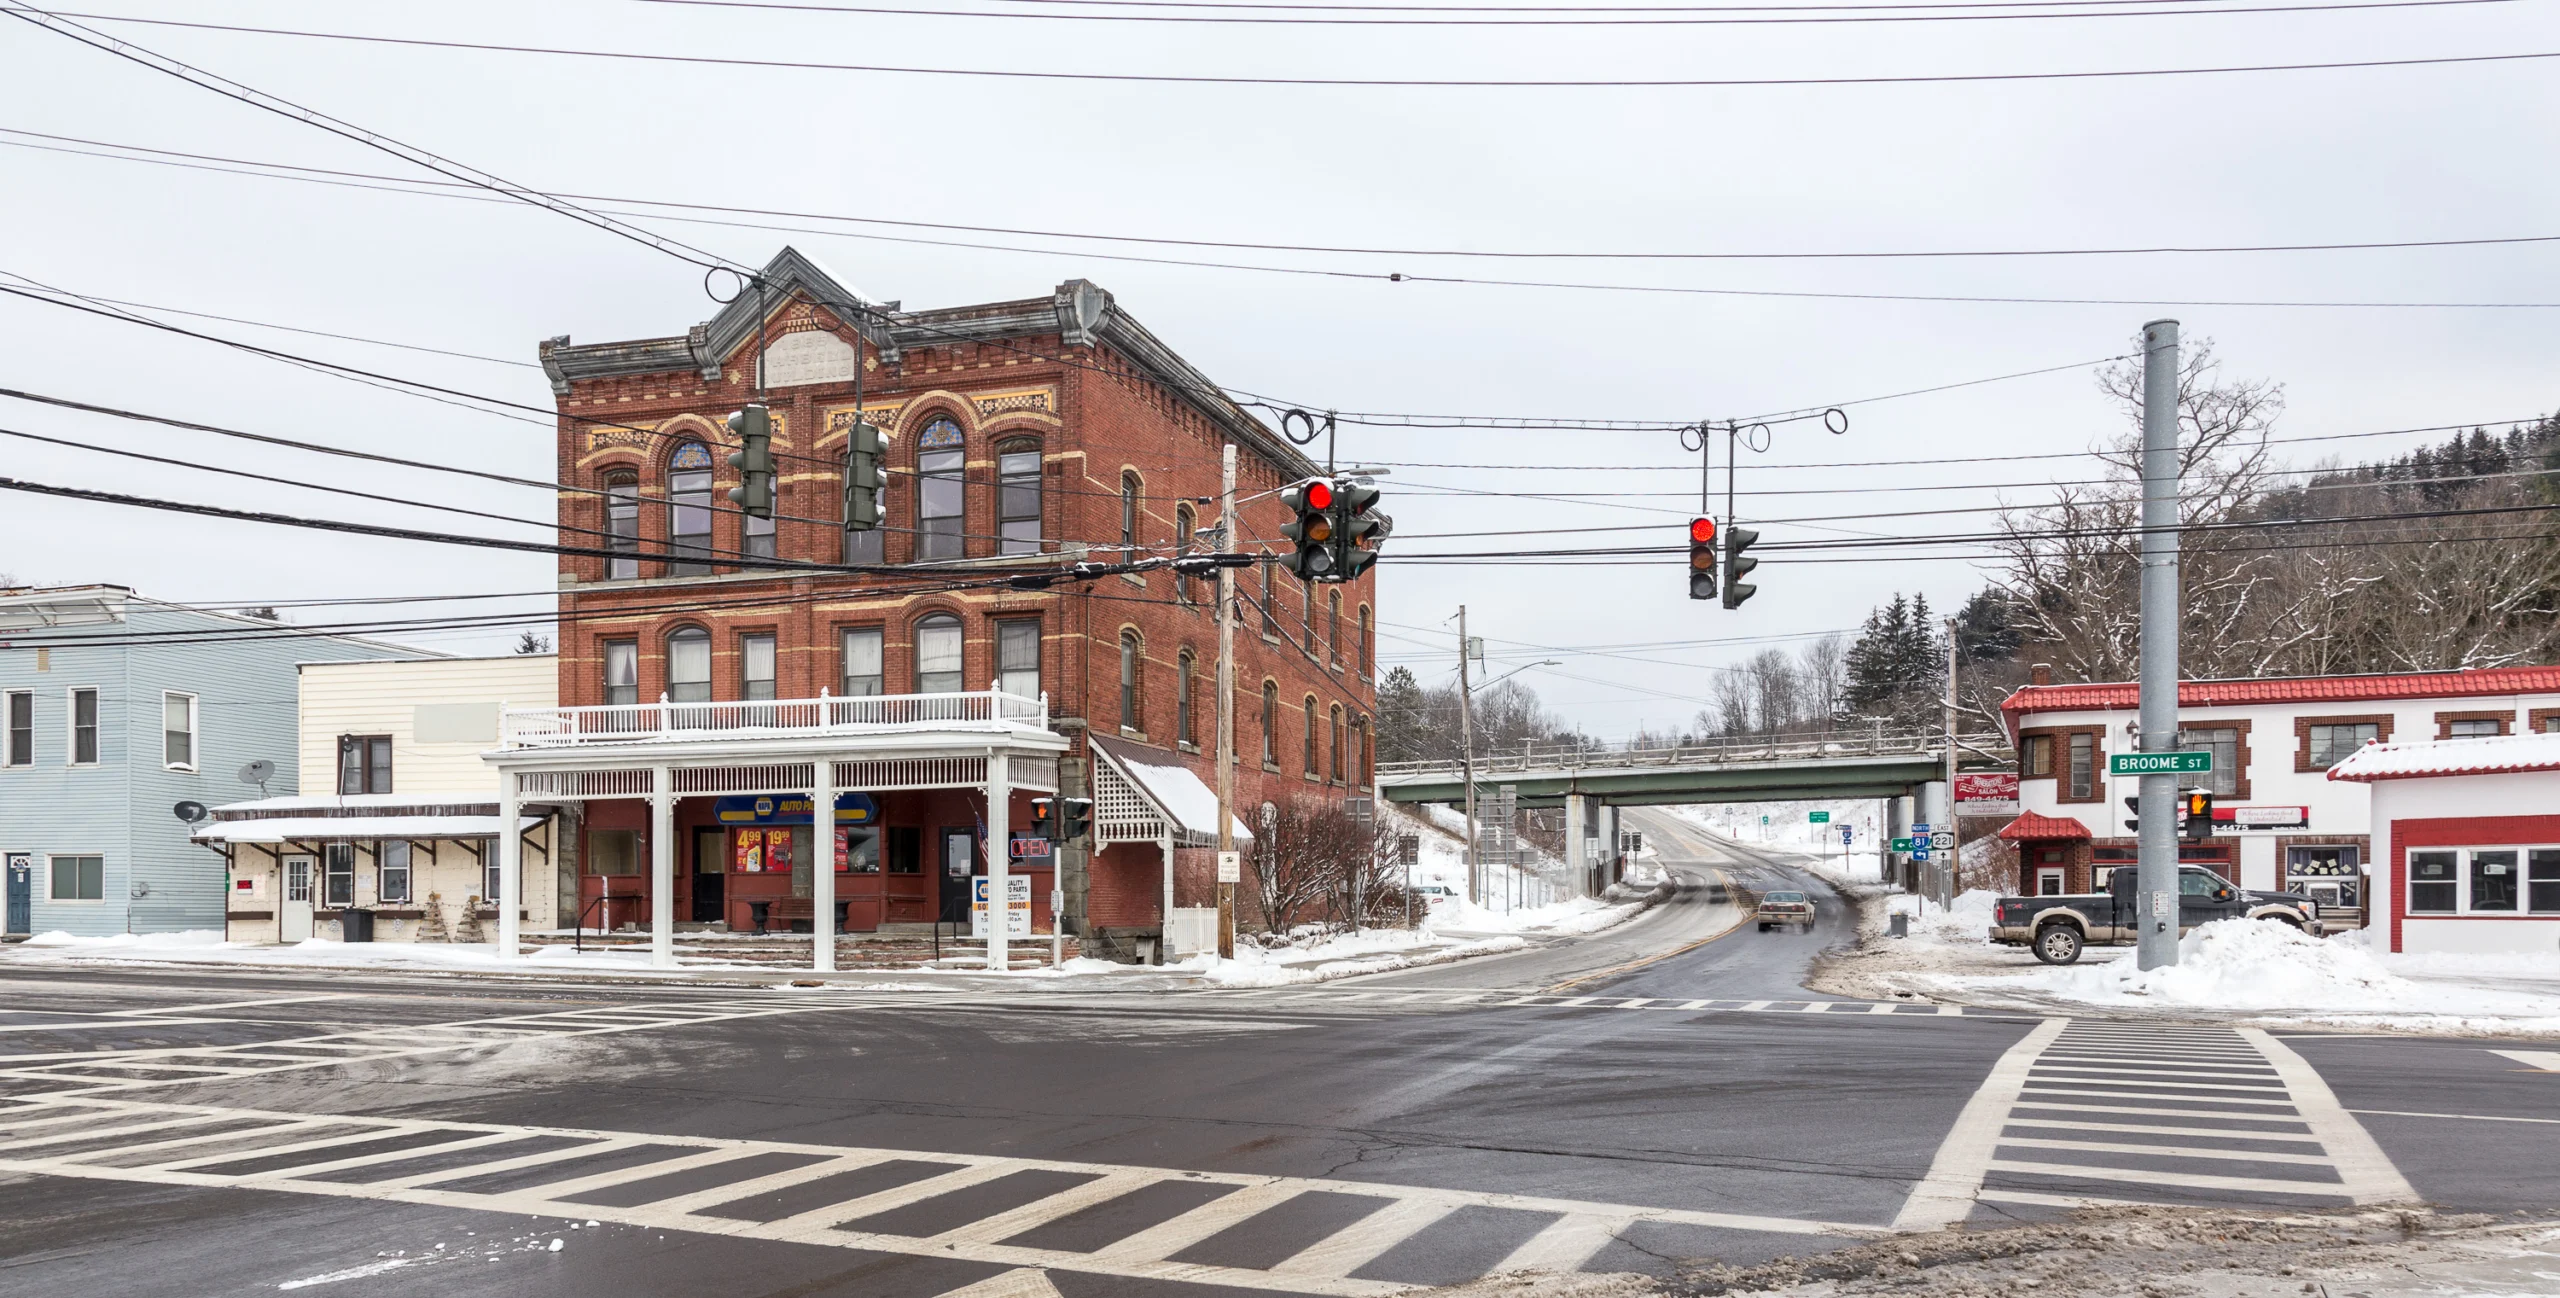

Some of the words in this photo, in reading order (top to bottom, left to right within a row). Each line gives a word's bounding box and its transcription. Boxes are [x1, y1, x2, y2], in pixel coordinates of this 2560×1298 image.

[2119, 756, 2180, 770] BROOME
[2188, 758, 2202, 768] ST
[757, 802, 771, 811] NAPA
[779, 801, 801, 811] AUTO
[2211, 824, 2249, 832] 9-4475
[1914, 837, 1926, 847] 81
[1934, 836, 1952, 846] 221
[1012, 840, 1049, 855] OPEN
